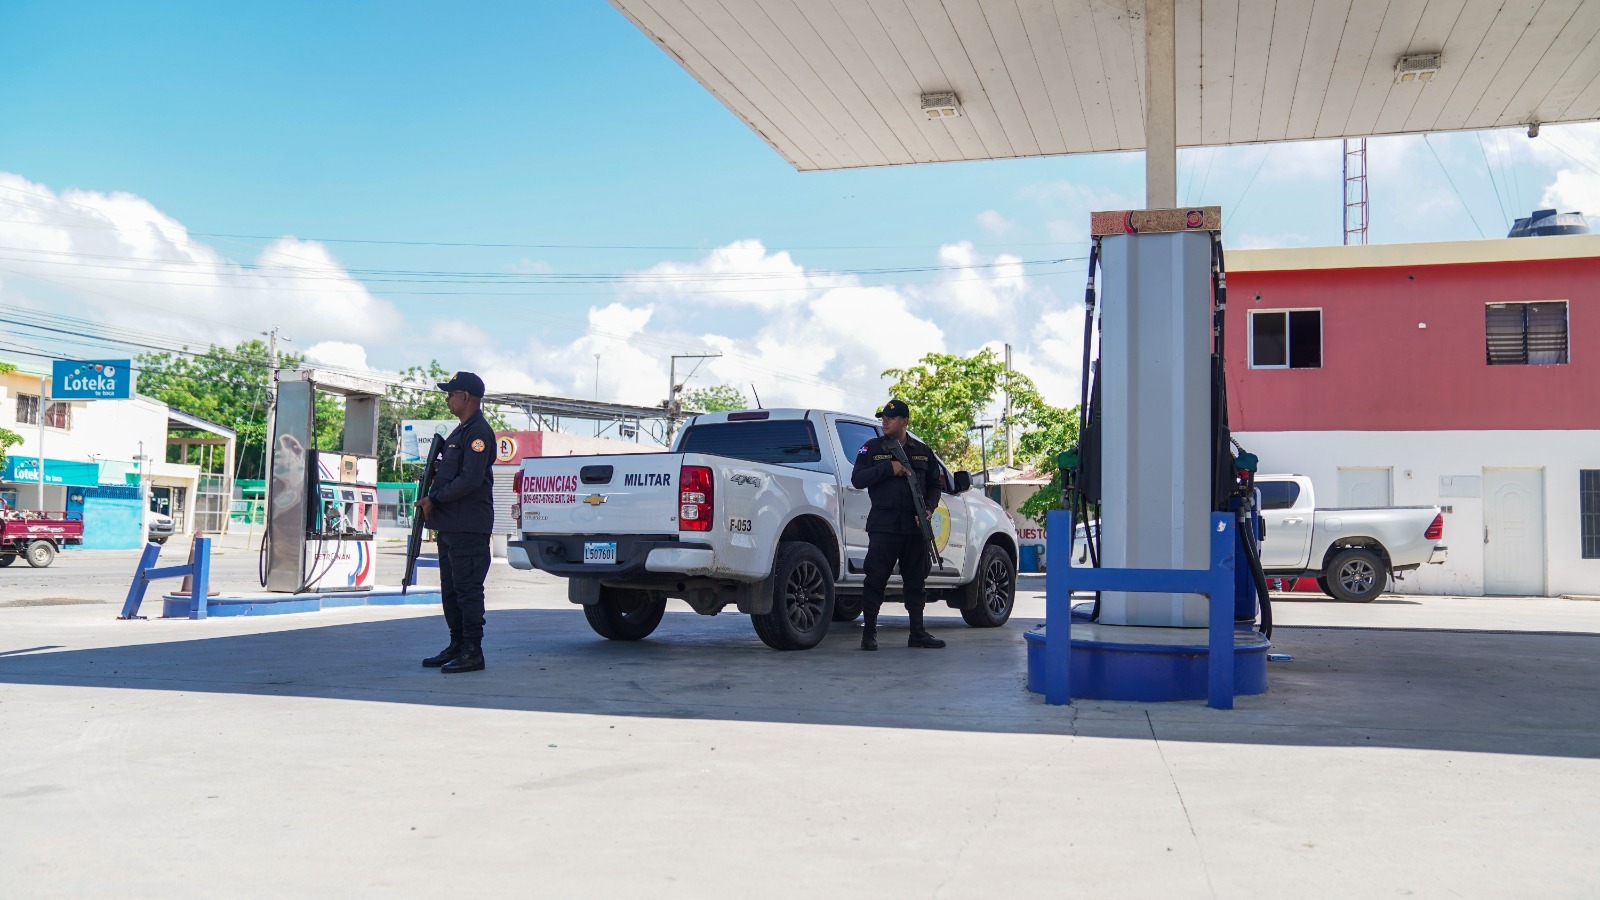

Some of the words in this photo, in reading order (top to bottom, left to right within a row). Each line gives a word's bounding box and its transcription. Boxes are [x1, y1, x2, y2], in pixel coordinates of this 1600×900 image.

[64, 375, 115, 391] Loteka
[14, 468, 41, 480] Lotek
[624, 474, 671, 486] MILITAR
[524, 475, 577, 492] DENUNCIAS
[730, 519, 751, 531] F-053
[585, 549, 614, 559] L507601
